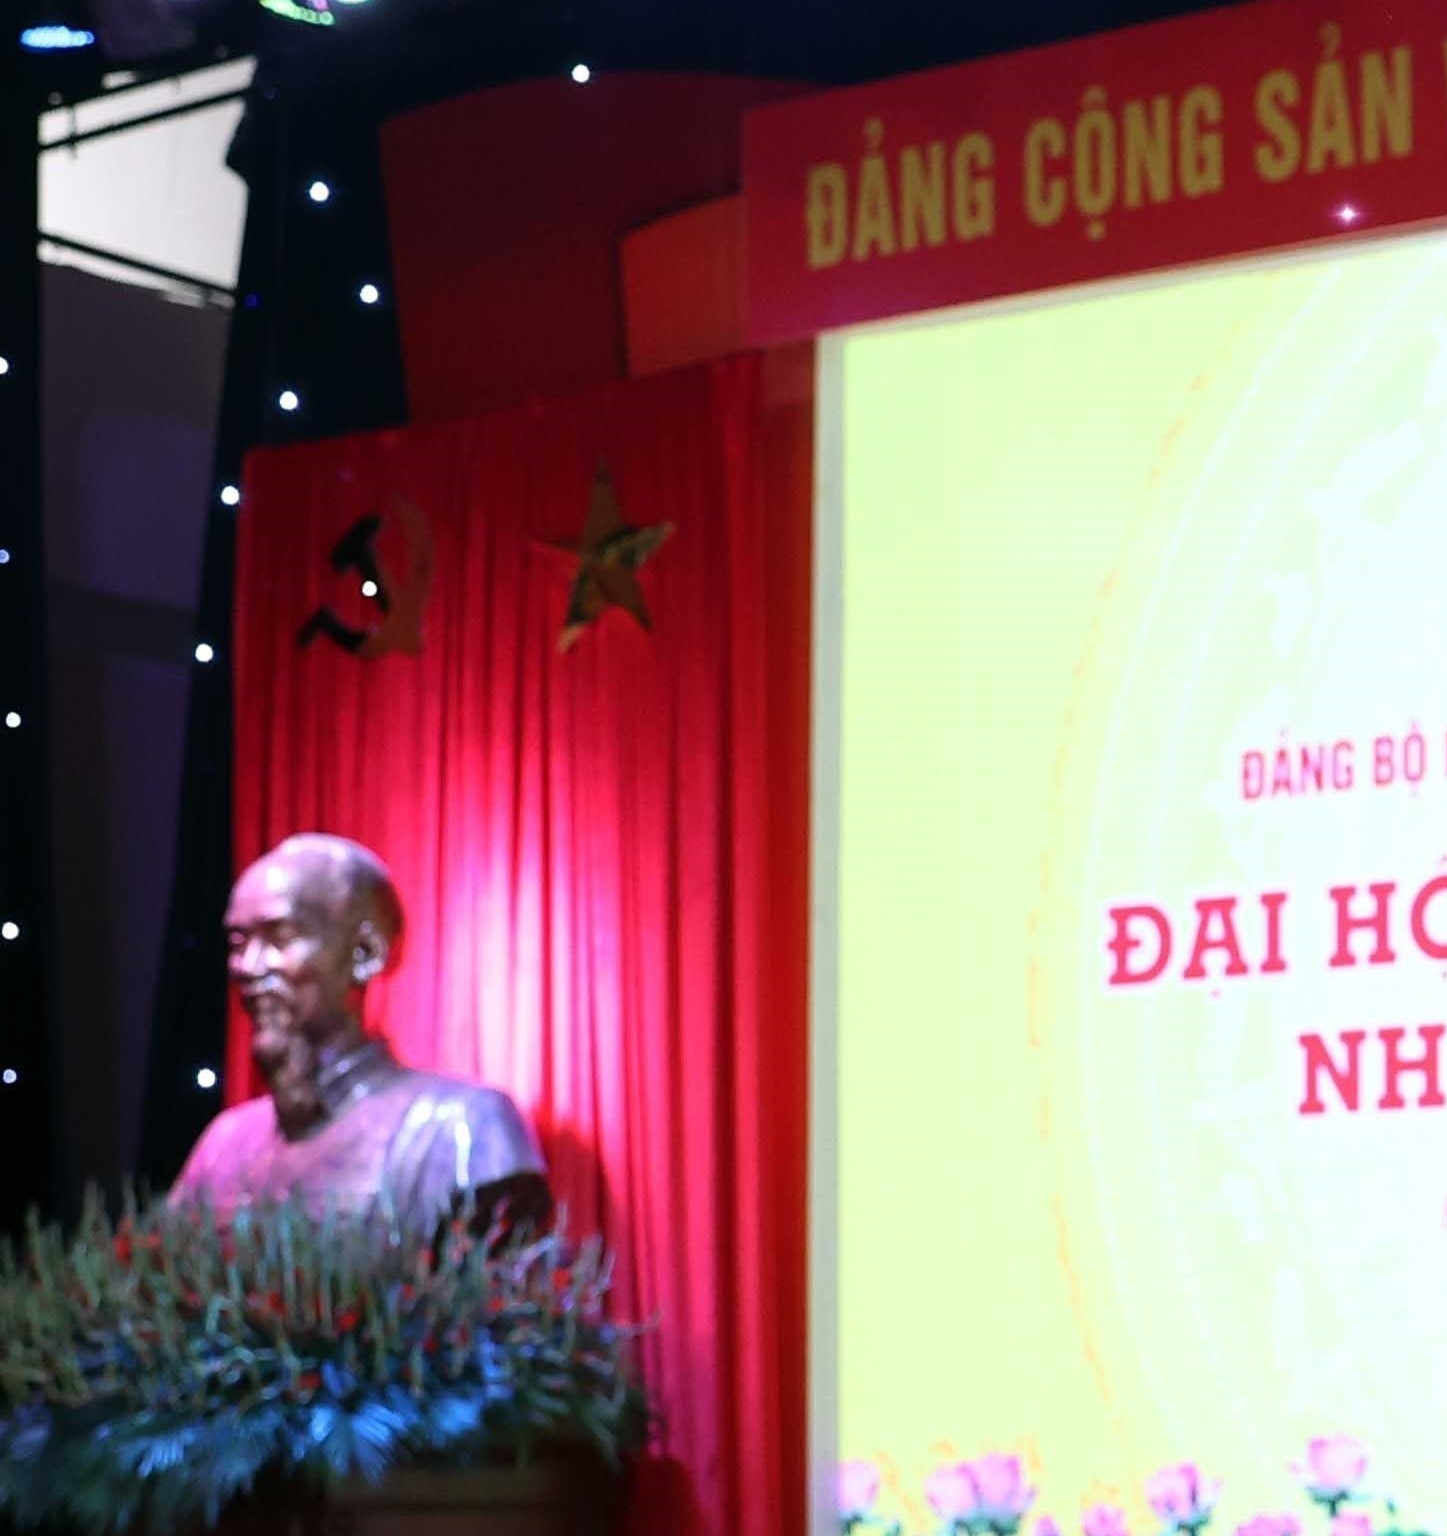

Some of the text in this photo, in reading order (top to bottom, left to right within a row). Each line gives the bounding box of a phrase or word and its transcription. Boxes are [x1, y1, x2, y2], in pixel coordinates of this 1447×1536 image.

[806, 118, 994, 270] ĐẢNG
[1023, 86, 1224, 240] CỘNG
[1254, 22, 1413, 184] SẢN
[1241, 726, 1355, 802] ĐẢNG
[1371, 716, 1427, 798] BỘ
[1107, 892, 1288, 998] ĐẠI
